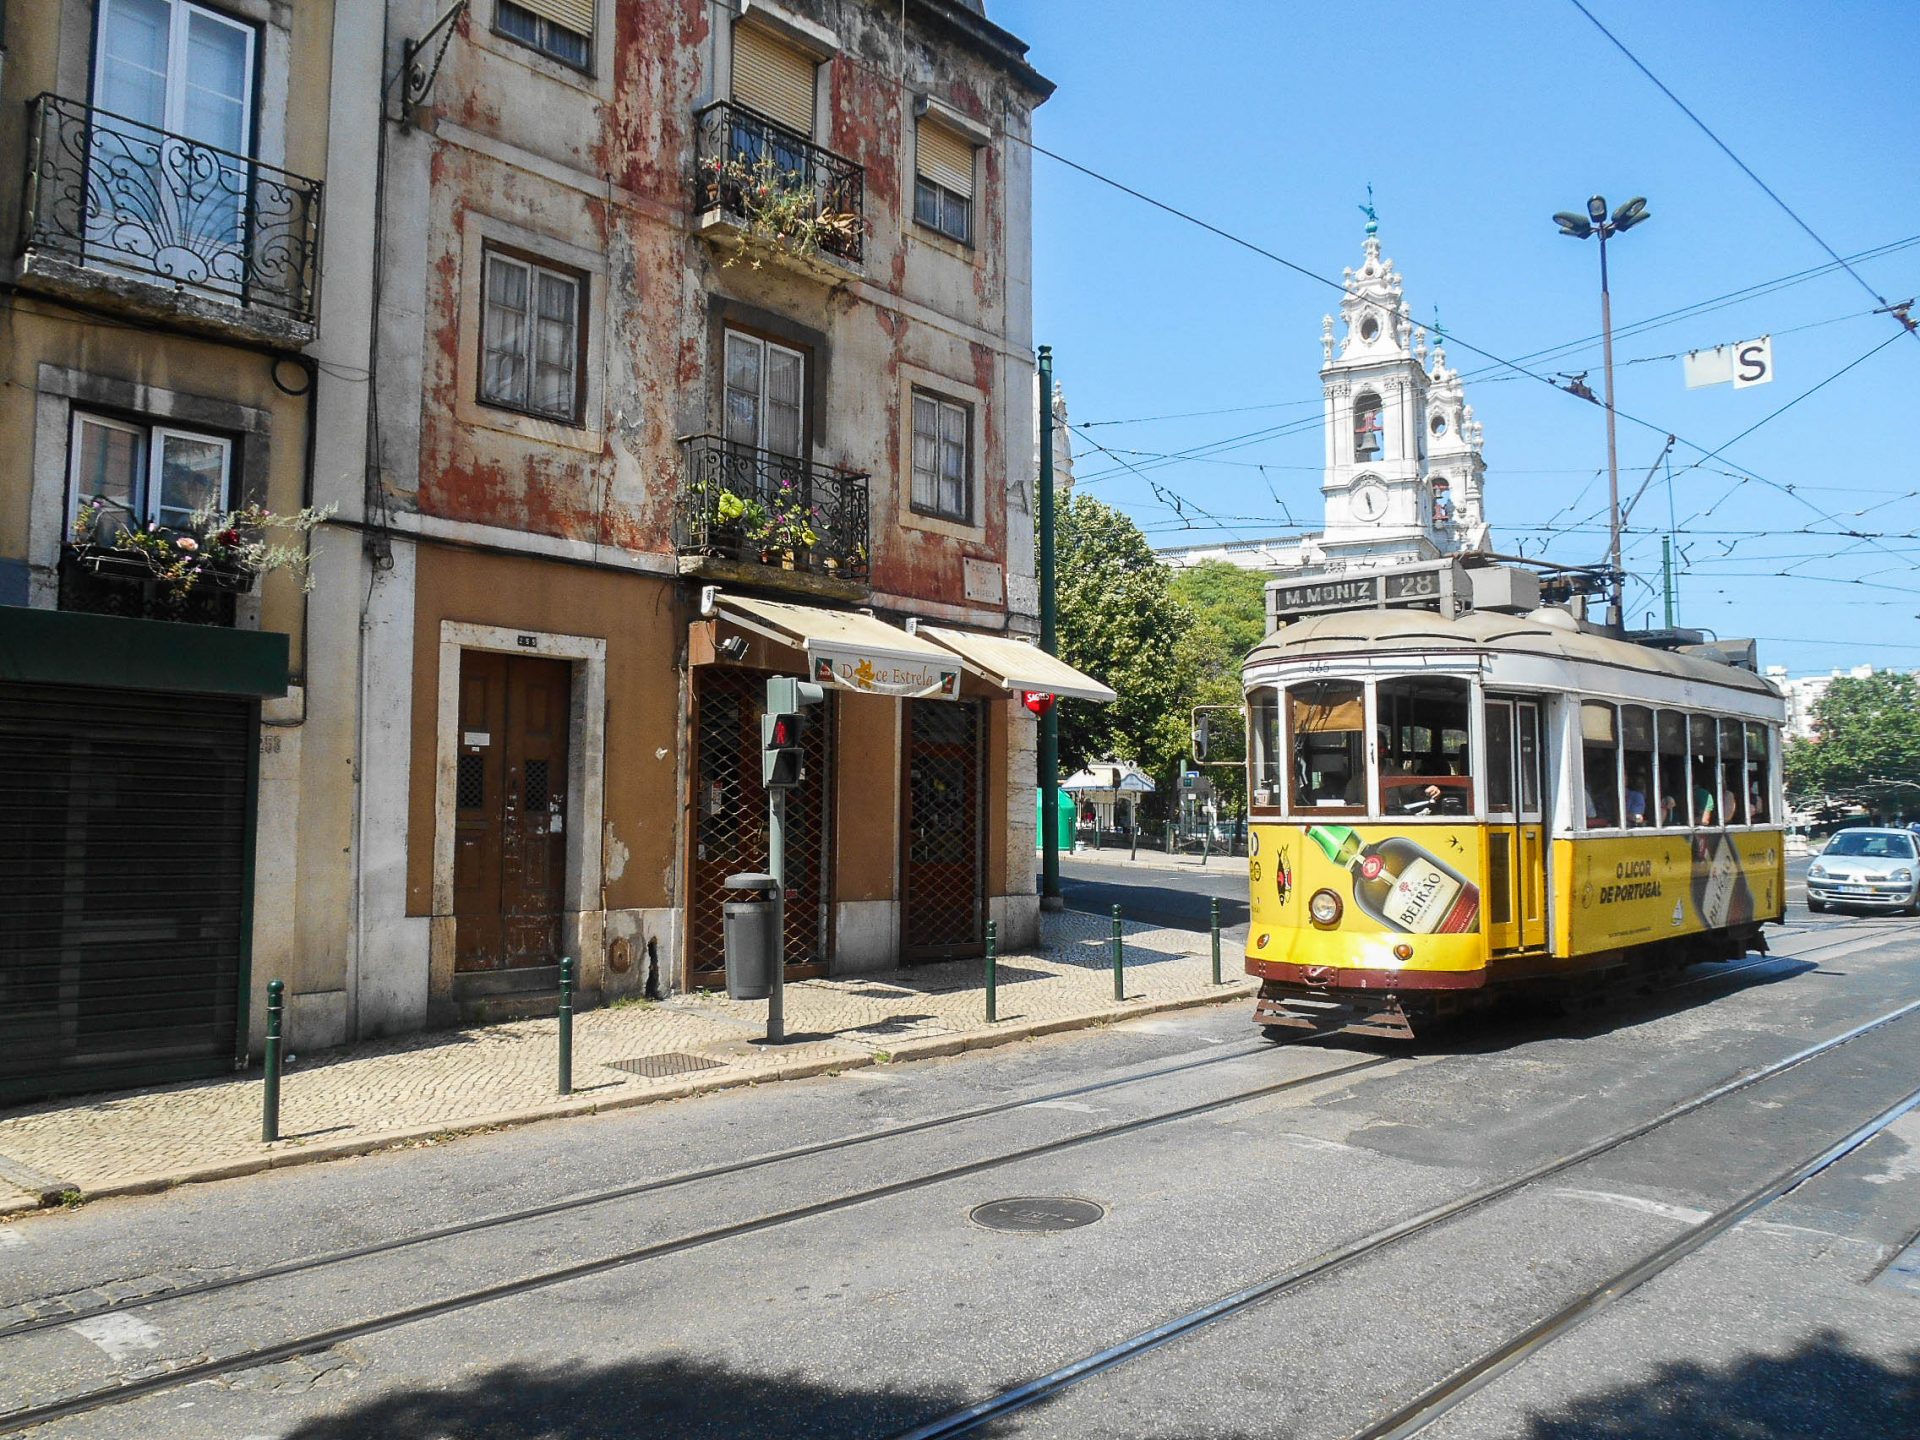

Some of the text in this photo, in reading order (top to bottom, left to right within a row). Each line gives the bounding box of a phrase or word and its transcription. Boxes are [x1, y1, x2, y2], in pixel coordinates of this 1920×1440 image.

[1738, 346, 1766, 382] S
[1401, 575, 1433, 595] 28
[893, 665, 933, 687] Estrela
[1616, 860, 1651, 878] O LICOR
[1400, 872, 1441, 925] BEIRÃO
[1600, 881, 1662, 904] DE PORTUGAL
